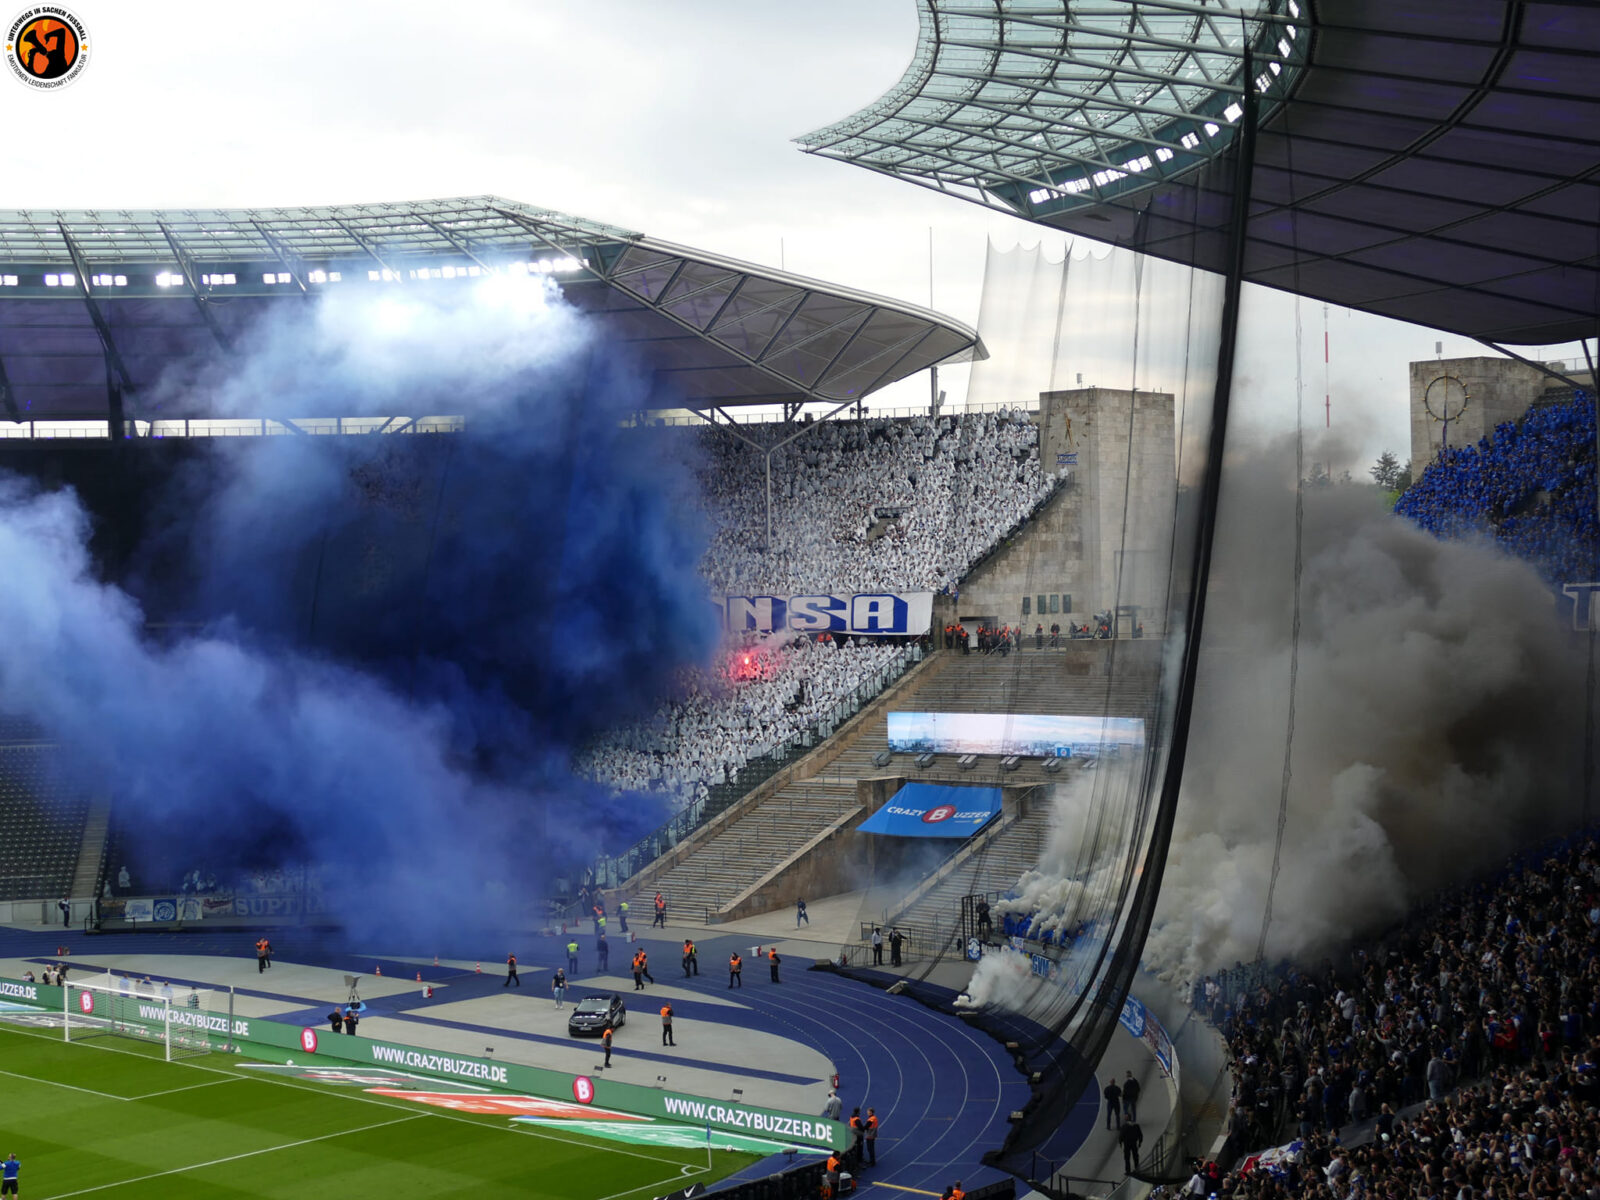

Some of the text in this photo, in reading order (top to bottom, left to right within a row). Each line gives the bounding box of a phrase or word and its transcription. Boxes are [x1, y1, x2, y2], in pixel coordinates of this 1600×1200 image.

[708, 594, 907, 633] NSA
[887, 806, 926, 817] CRAZY
[372, 1045, 508, 1083] WWW.CRAZYBUZZER.DE
[664, 1097, 833, 1143] WWW.CRAZYBUZZER.DE
